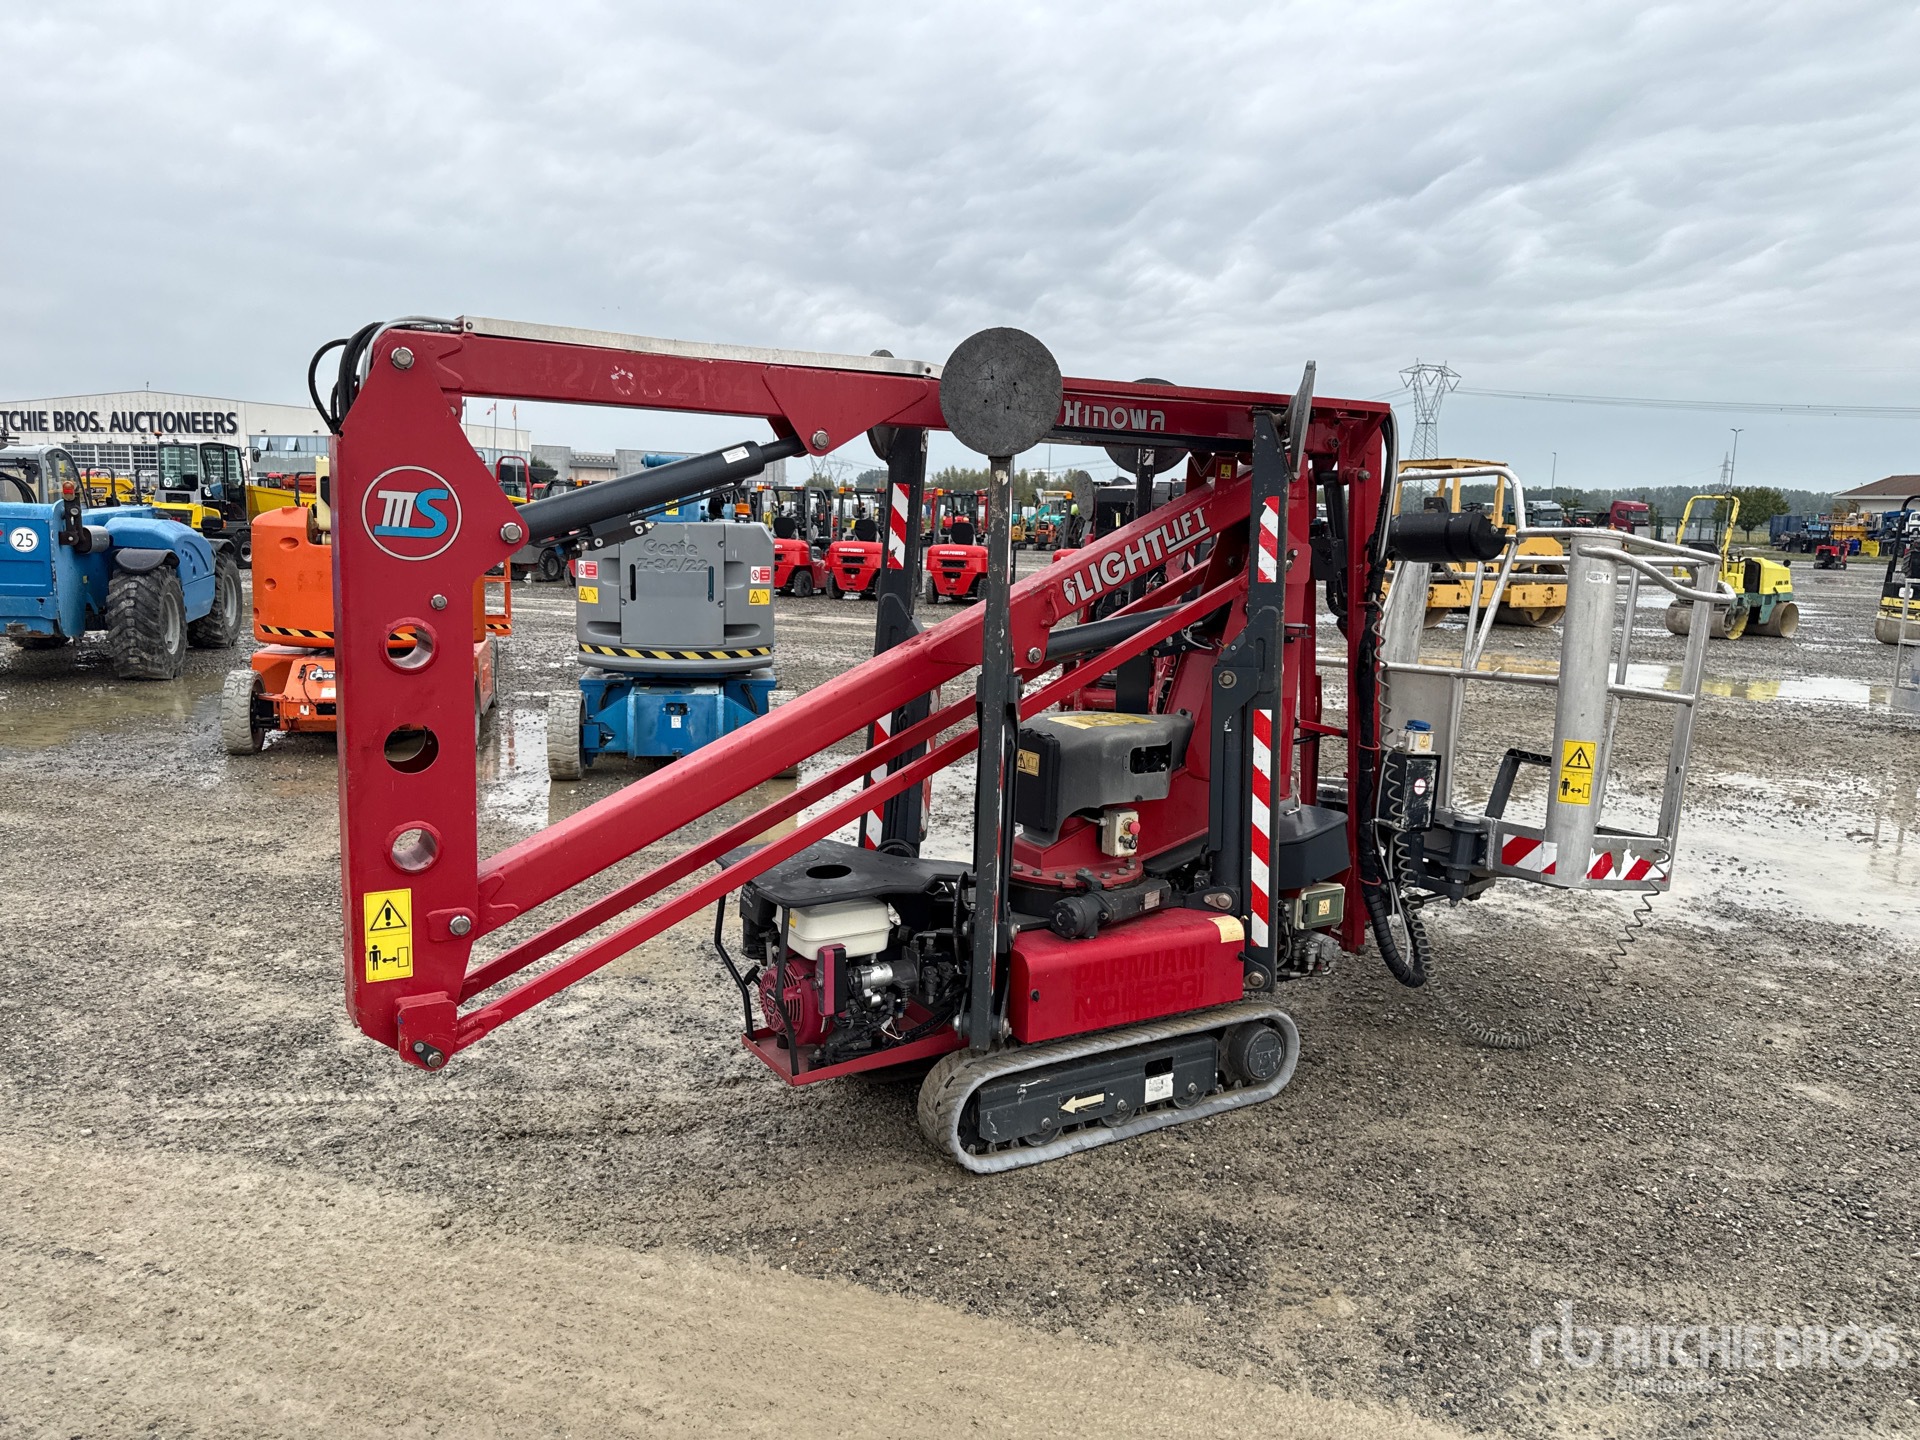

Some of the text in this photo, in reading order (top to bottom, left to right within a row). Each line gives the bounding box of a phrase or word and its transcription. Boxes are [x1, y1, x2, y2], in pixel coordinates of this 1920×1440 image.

[53, 410, 104, 433] BROS.
[109, 411, 238, 434] AUCTIONEERS
[16, 533, 34, 547] 25
[643, 538, 698, 557] Genie
[636, 557, 709, 573] Z-34/22
[1074, 943, 1207, 991] PARMIANI
